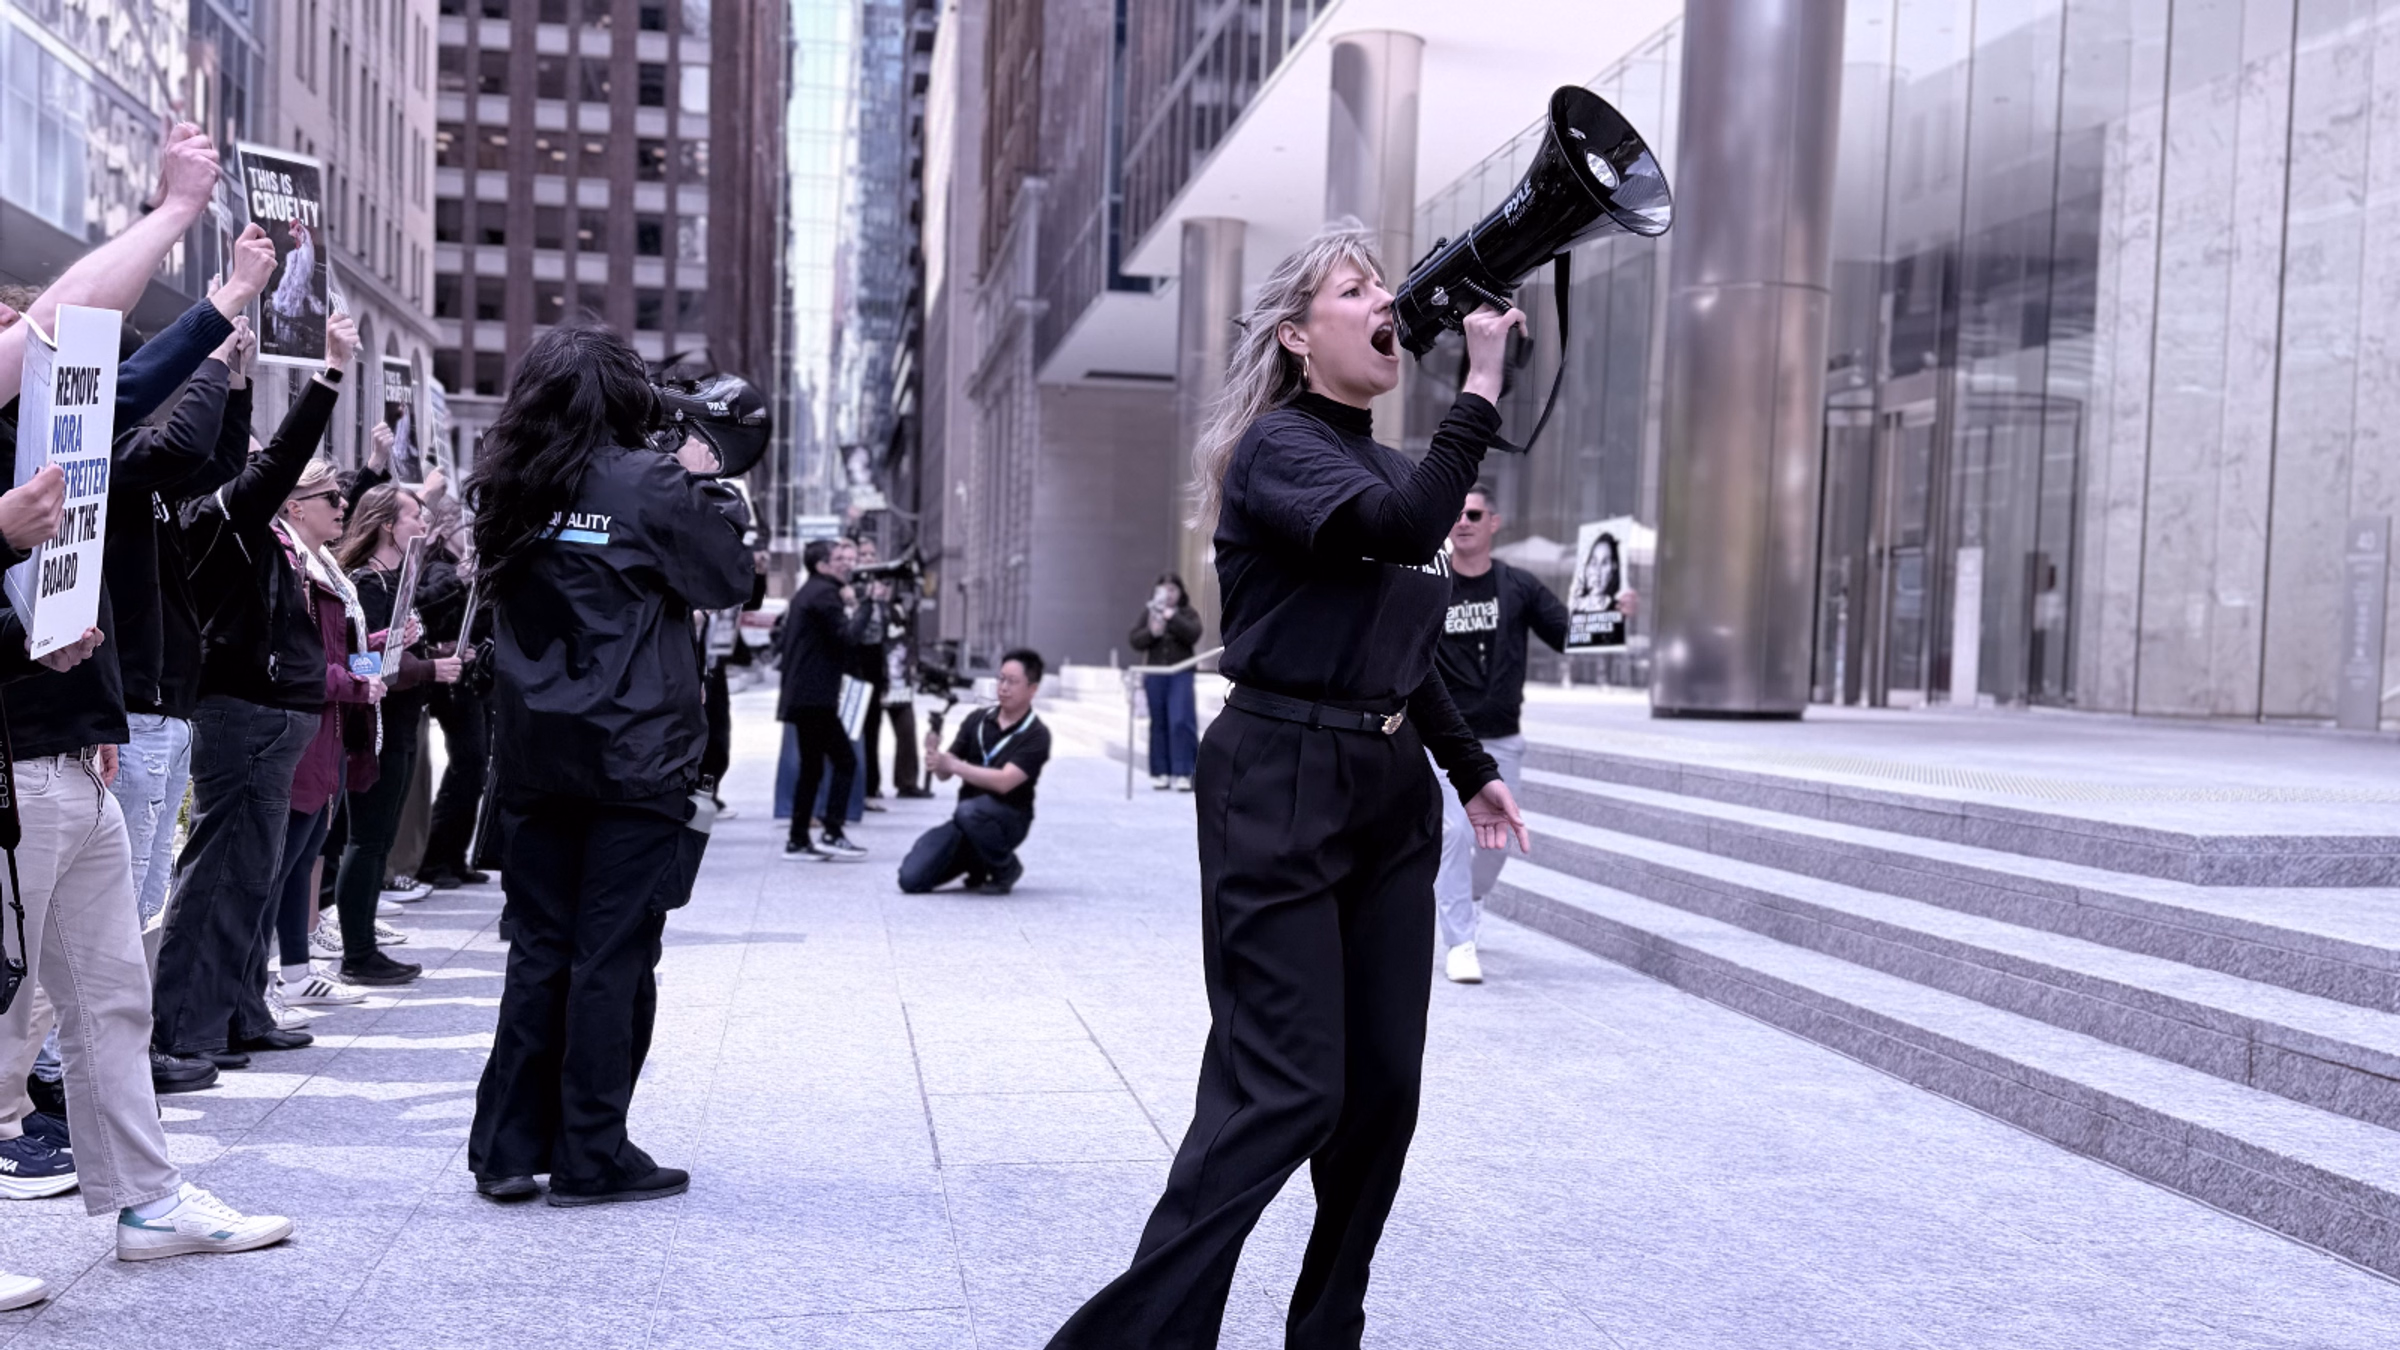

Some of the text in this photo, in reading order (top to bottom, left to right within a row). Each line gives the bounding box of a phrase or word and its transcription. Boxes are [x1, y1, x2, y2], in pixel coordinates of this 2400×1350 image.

[248, 167, 293, 195] THIS IS
[1504, 178, 1532, 218] PYLE
[252, 190, 319, 228] CRUELTY
[55, 366, 101, 406] REMOVE
[51, 414, 82, 454] NORA
[54, 457, 108, 499] FREITER
[77, 503, 99, 542] THE
[42, 552, 78, 598] BOARD
[1445, 614, 1499, 633] EQUALI
[1446, 597, 1499, 620] animal
